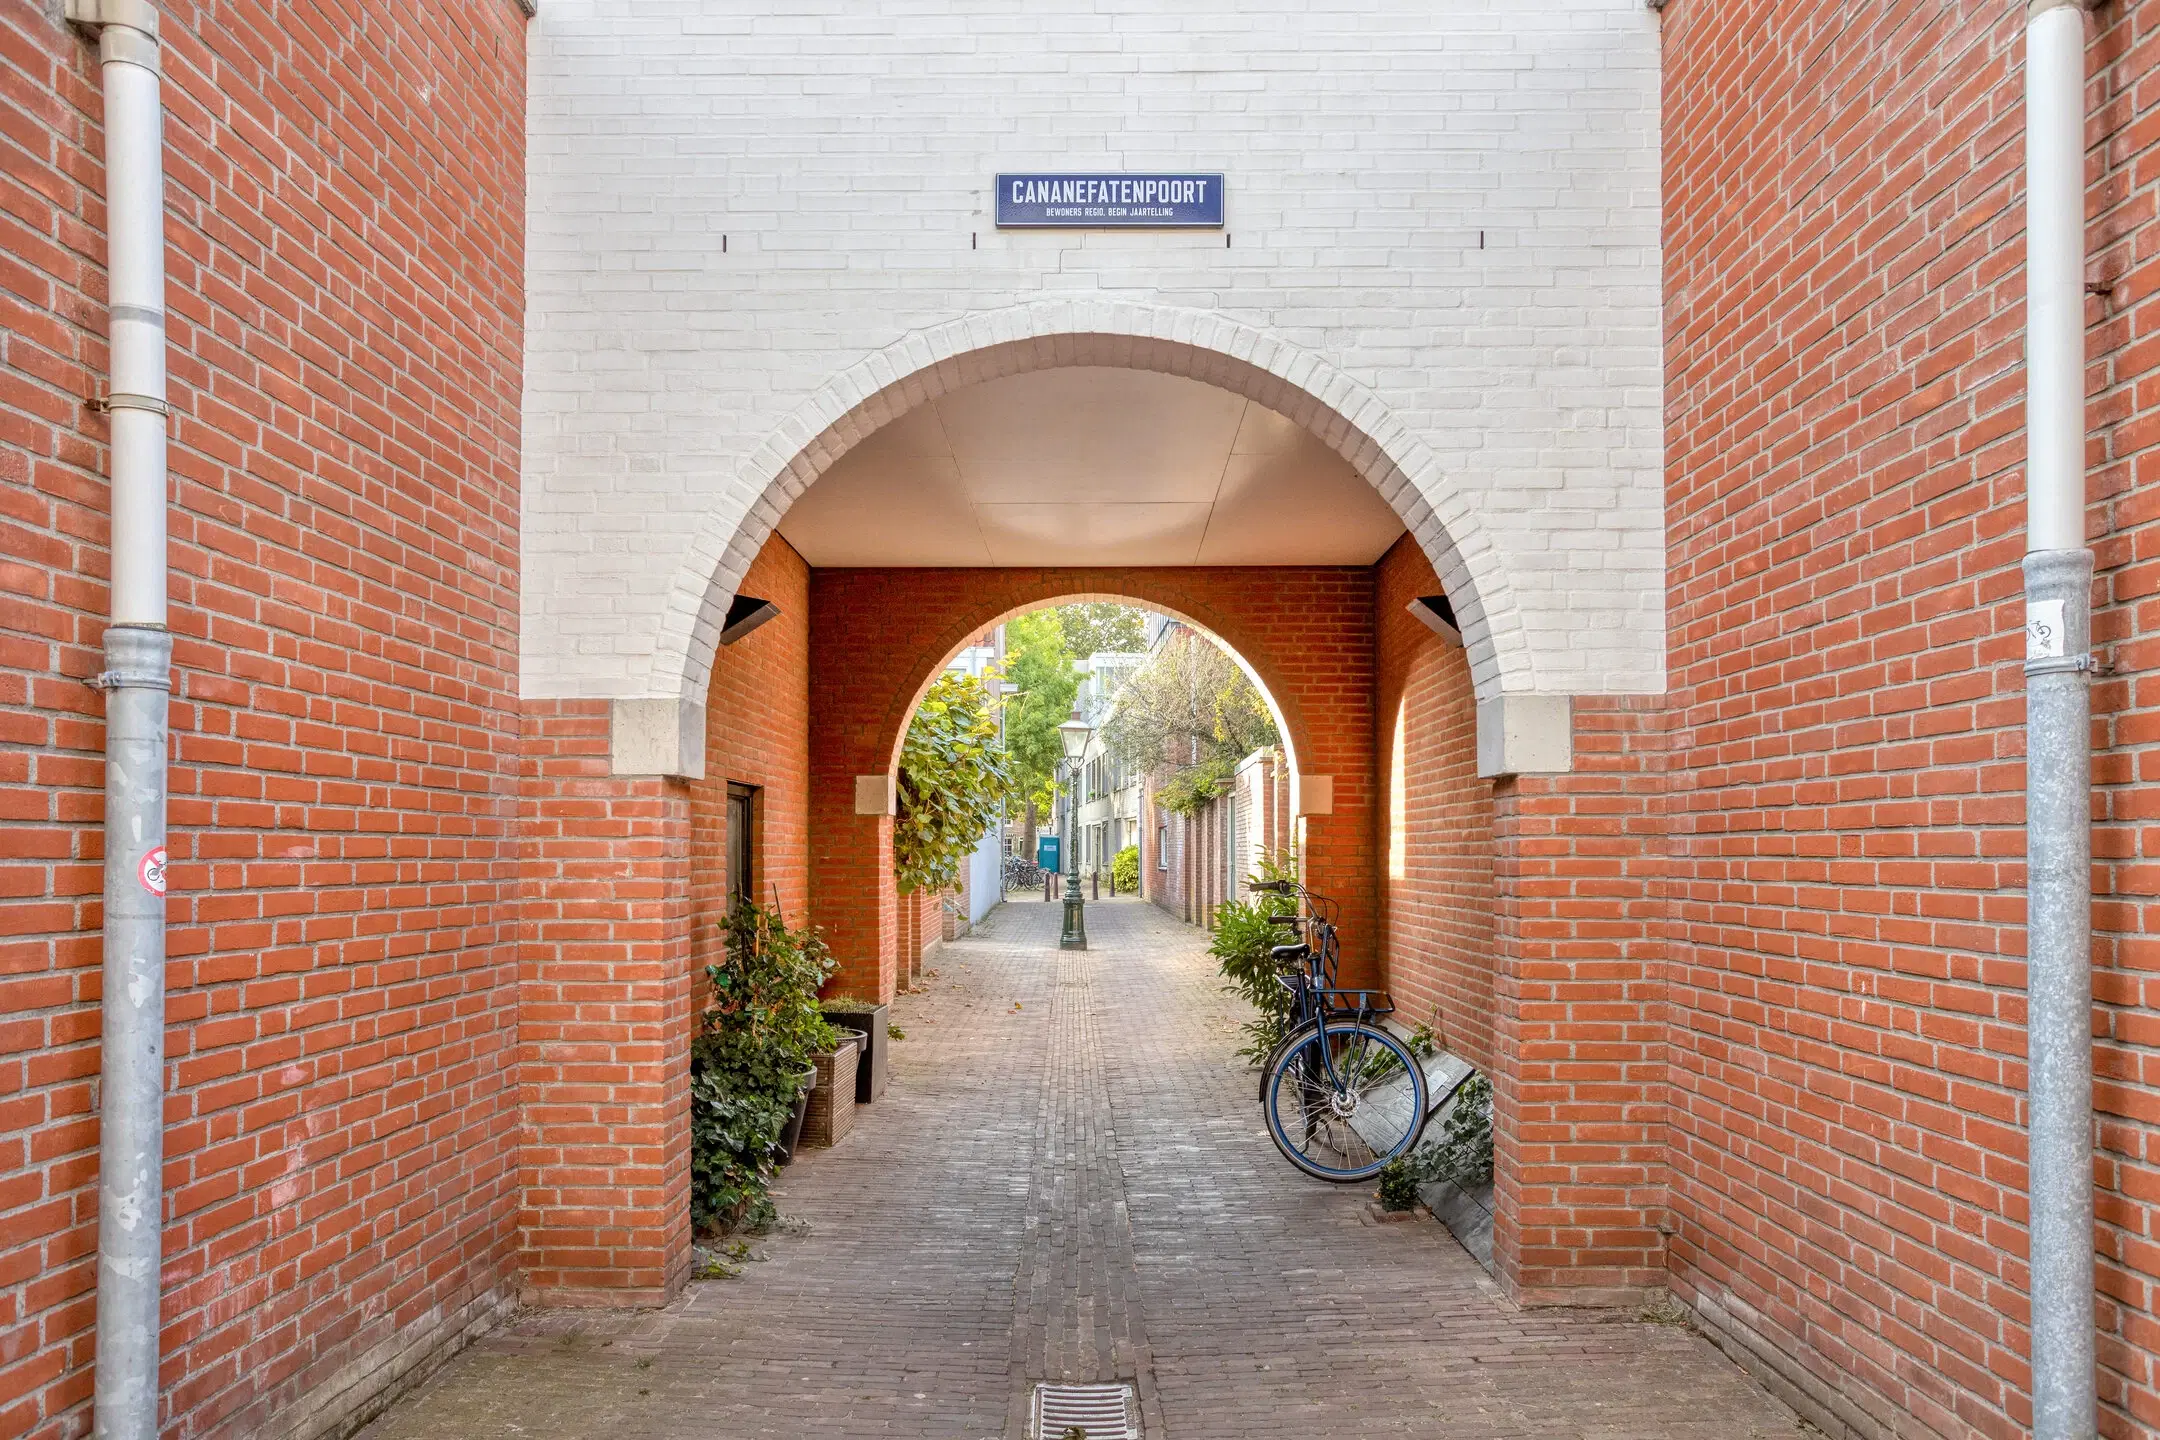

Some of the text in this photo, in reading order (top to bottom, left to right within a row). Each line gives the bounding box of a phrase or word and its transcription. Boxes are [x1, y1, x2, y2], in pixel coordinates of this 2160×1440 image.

[1012, 180, 1207, 204] CANANEFATENPOORT
[1046, 207, 1082, 217] BEWONERS
[1108, 207, 1127, 217] BEGIN
[1129, 207, 1174, 217] JAARTELLING
